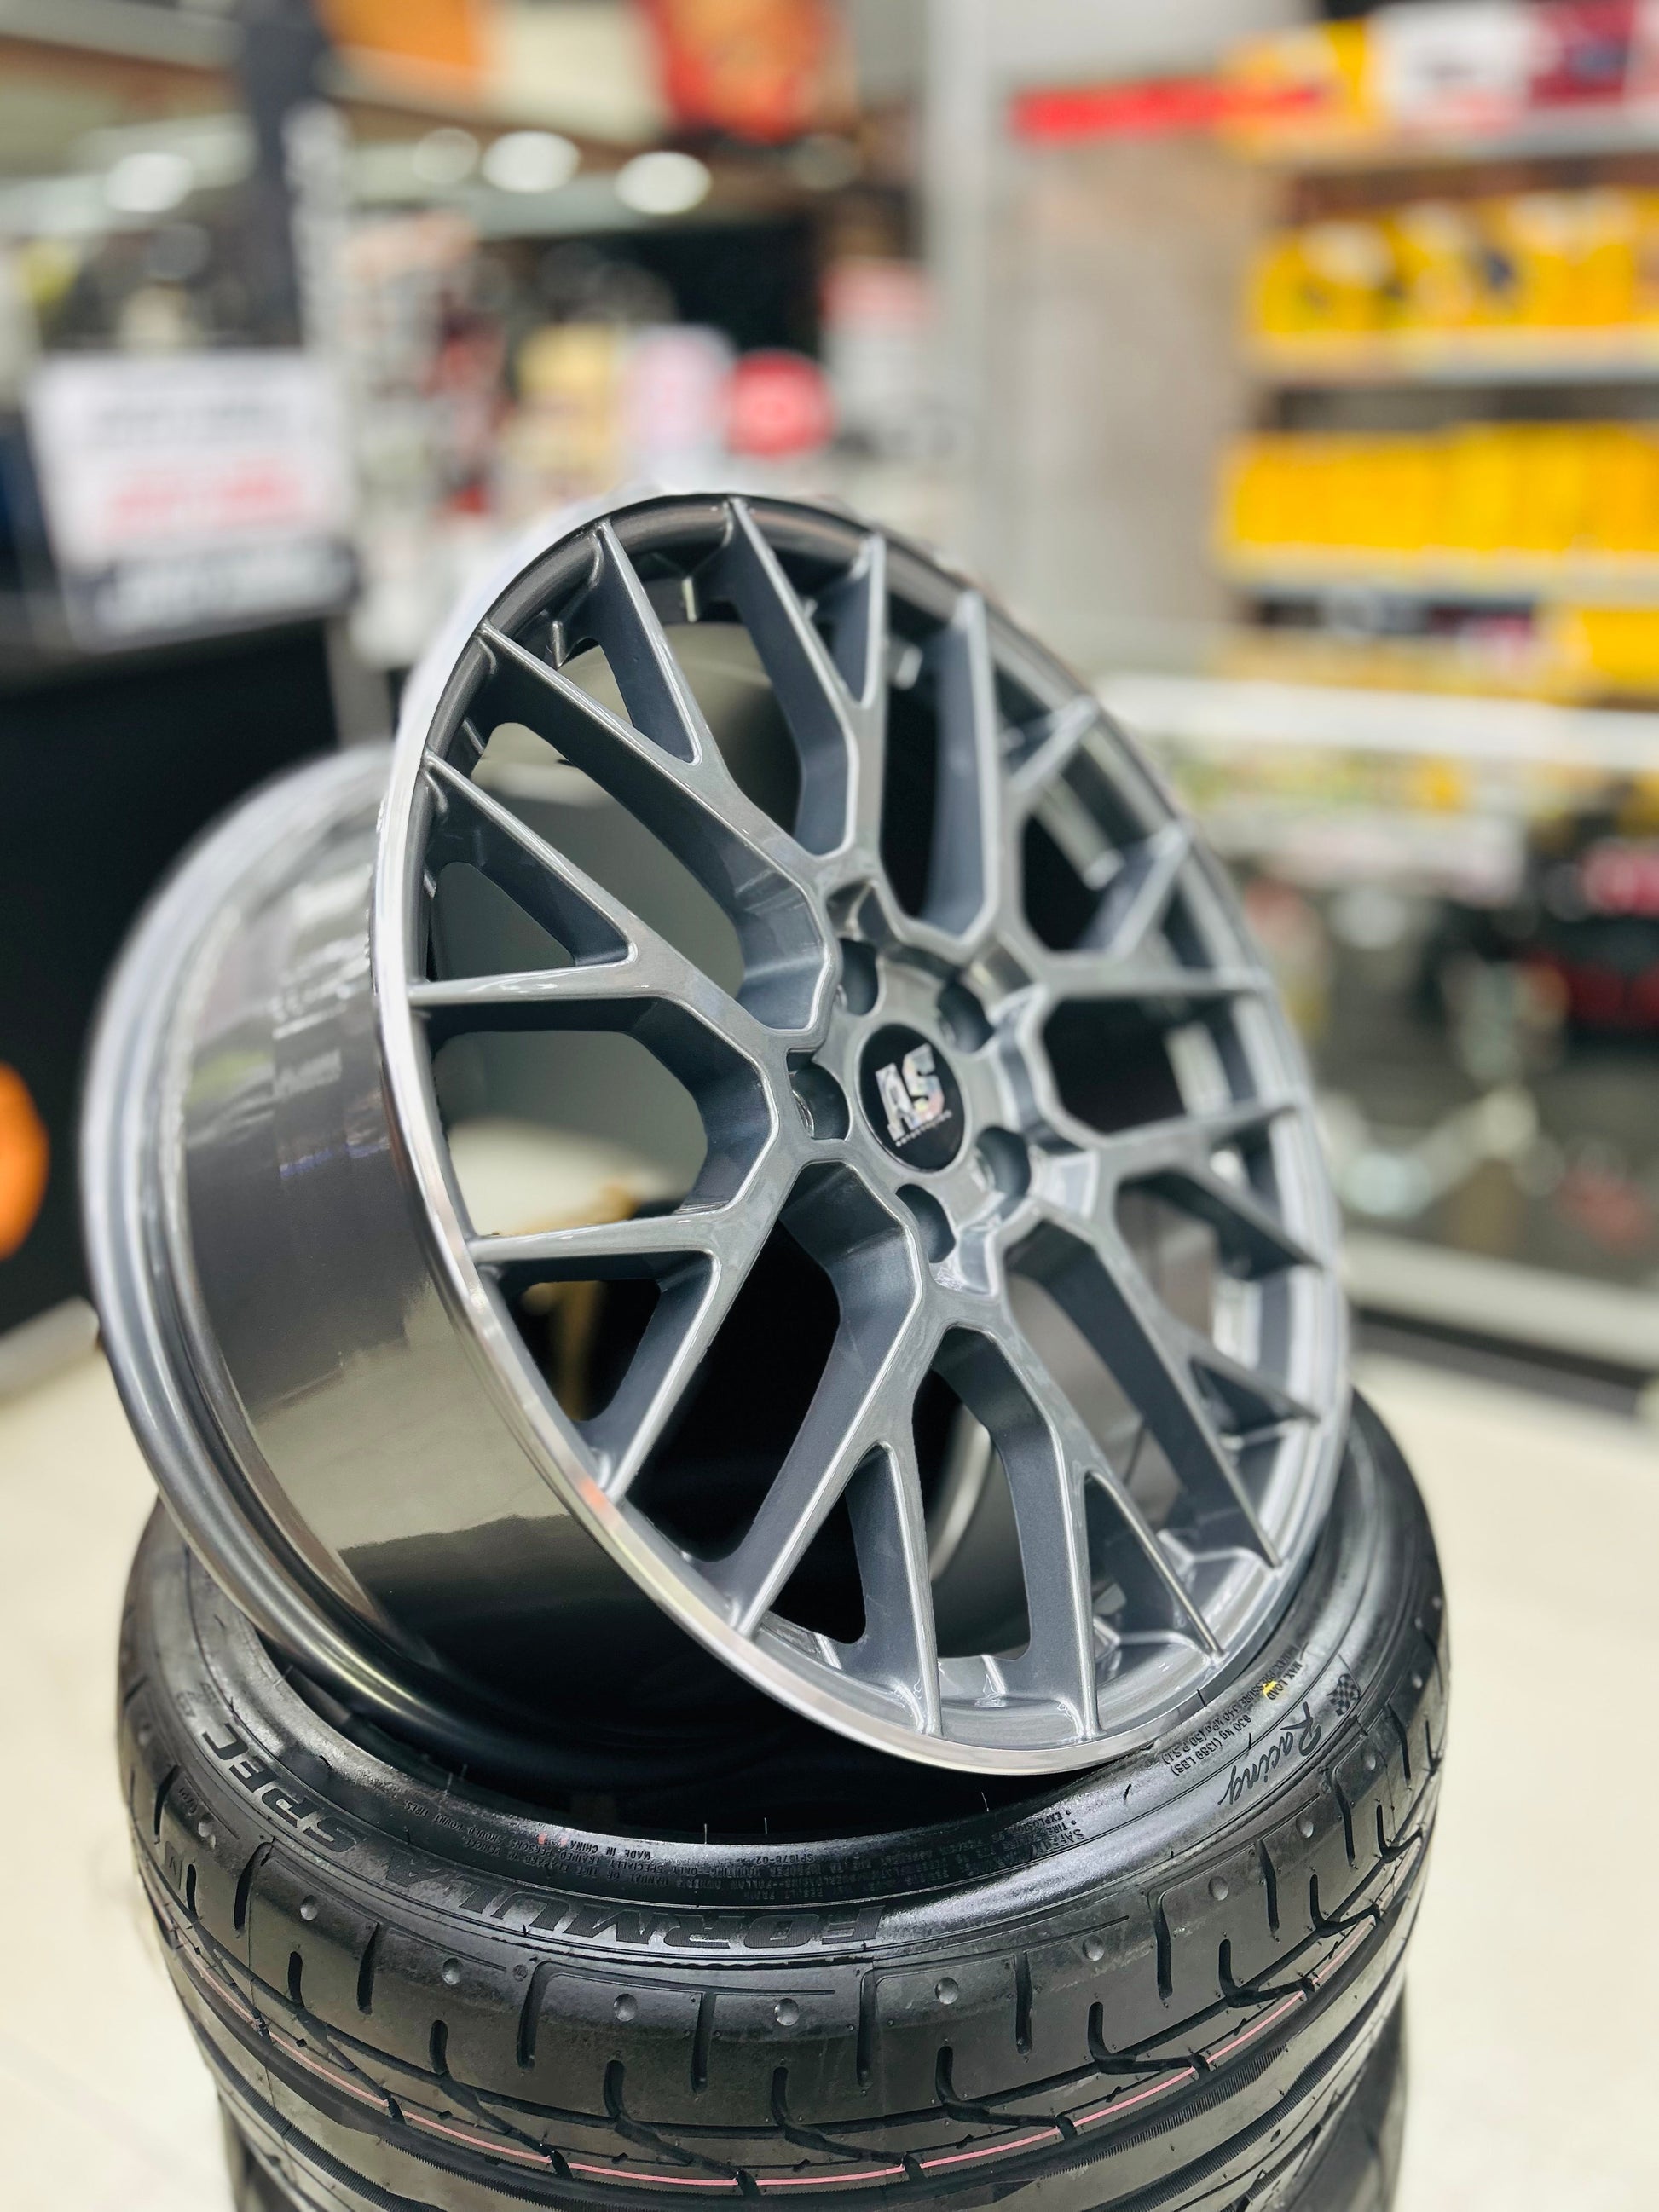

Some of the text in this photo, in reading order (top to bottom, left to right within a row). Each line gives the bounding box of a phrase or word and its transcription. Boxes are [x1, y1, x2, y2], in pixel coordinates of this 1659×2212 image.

[876, 1042, 945, 1141] AS
[1282, 1660, 1303, 1682] MAX.
[1238, 1668, 1276, 1708] PRESSURE
[1264, 1678, 1288, 1702] LOAD
[1186, 1730, 1209, 1747] (50
[1217, 1726, 1235, 1741] kg
[1217, 1701, 1322, 1805] Racing
[1168, 1754, 1197, 1777] LBS)
[202, 1723, 356, 1852] SPEC
[466, 1824, 505, 1845] SHOULD
[1045, 1821, 1068, 1837] TIRE
[508, 1838, 553, 1857] PERSONS
[569, 1839, 651, 1861] MADE IN CHINA
[1032, 1827, 1085, 1857] SAFETY
[506, 1850, 519, 1862] IN
[558, 1851, 600, 1866] TRAINED
[609, 1857, 663, 1873] SPECIALLY
[574, 1865, 597, 1878] TIRE
[604, 1868, 621, 1881] OR
[627, 1871, 669, 1886] MANUAL
[385, 1848, 886, 1949] FORMULA
